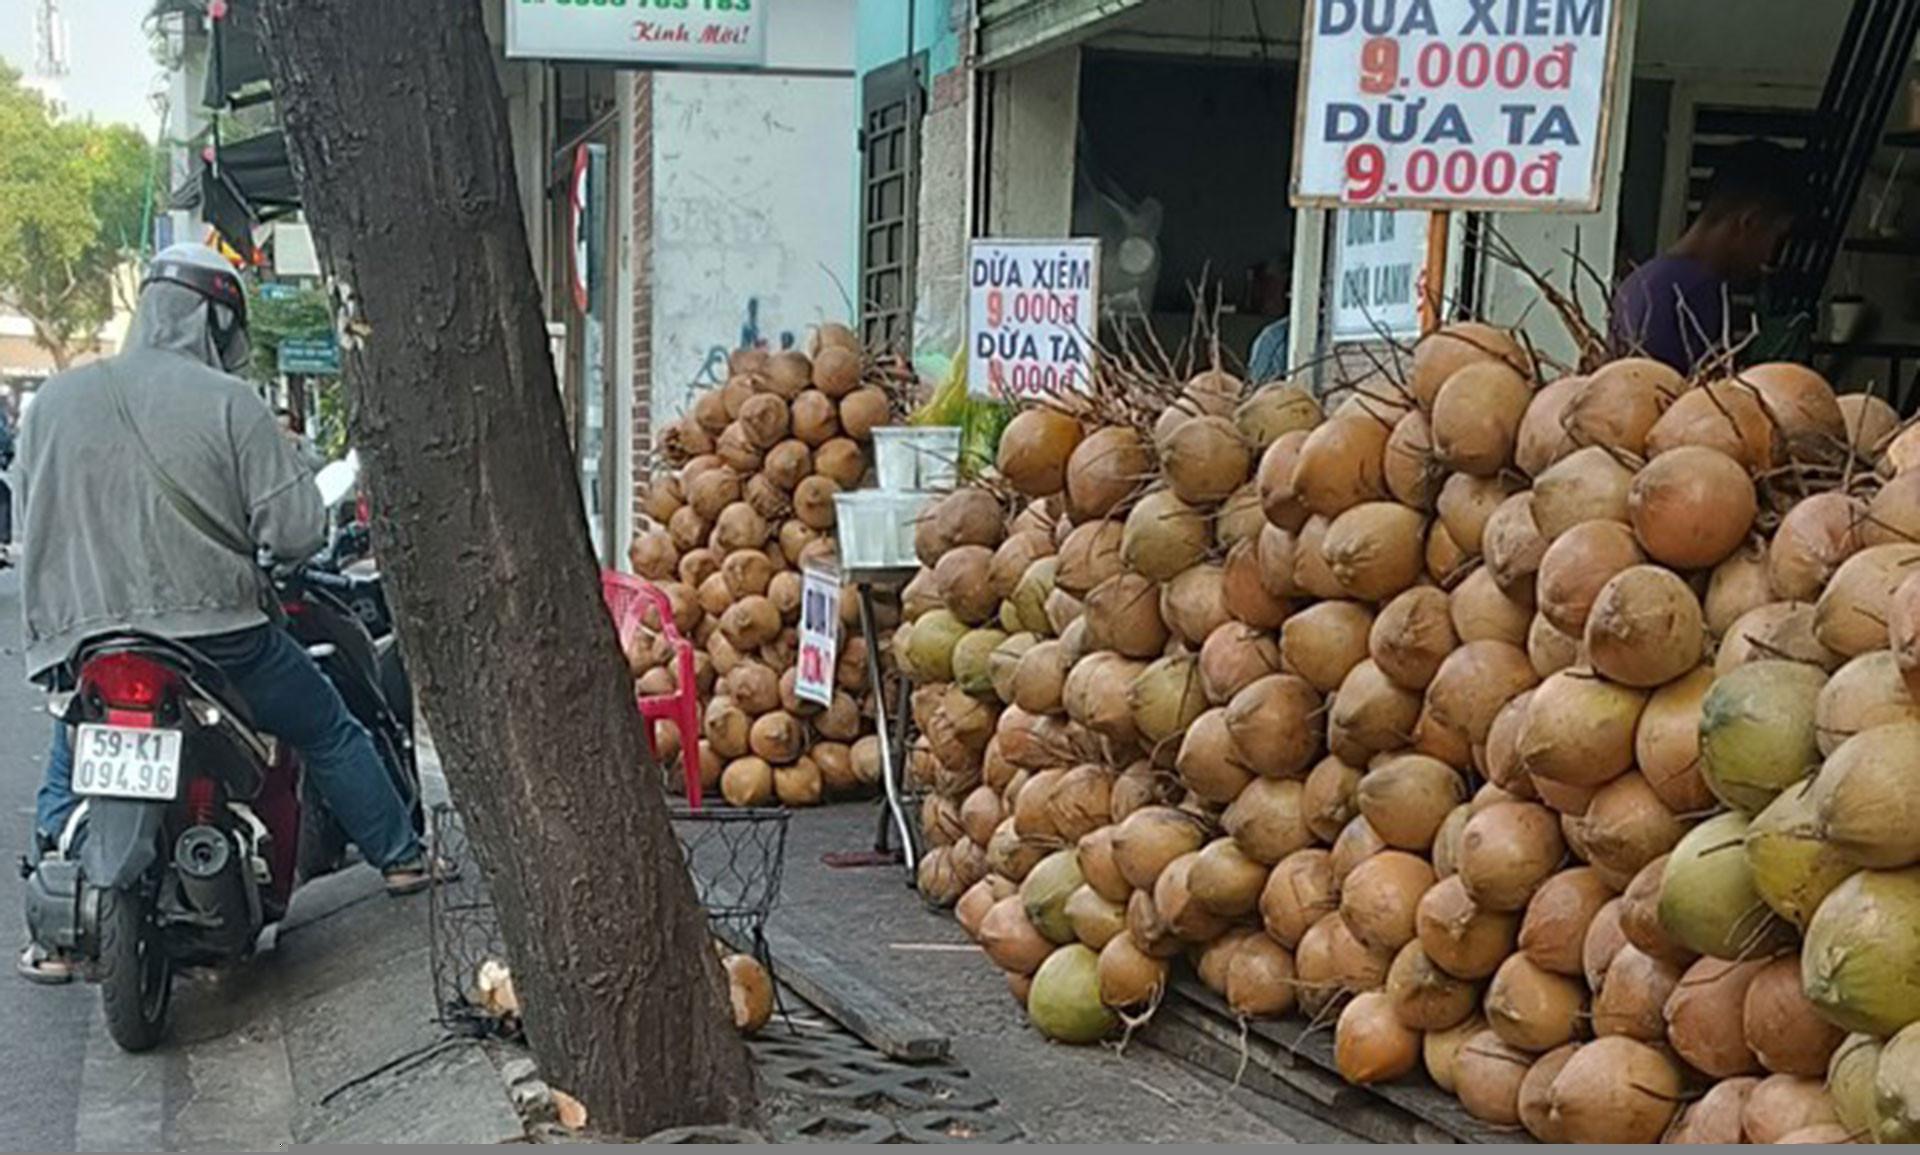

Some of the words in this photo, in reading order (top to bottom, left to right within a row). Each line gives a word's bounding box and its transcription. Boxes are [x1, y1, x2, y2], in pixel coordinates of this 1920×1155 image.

[1360, 37, 1577, 94] 9.000đ
[1324, 94, 1473, 143] DỪA
[1501, 104, 1580, 145] TA
[1344, 143, 1562, 200] 9.000đ
[972, 250, 1023, 288] DỪA
[1033, 251, 1090, 290] XIÊM
[987, 290, 1078, 328] 9.000đ
[977, 326, 1039, 361] DỪA
[1049, 334, 1081, 363] TA
[92, 730, 163, 762] 59-K1
[79, 760, 172, 794] 094.96
